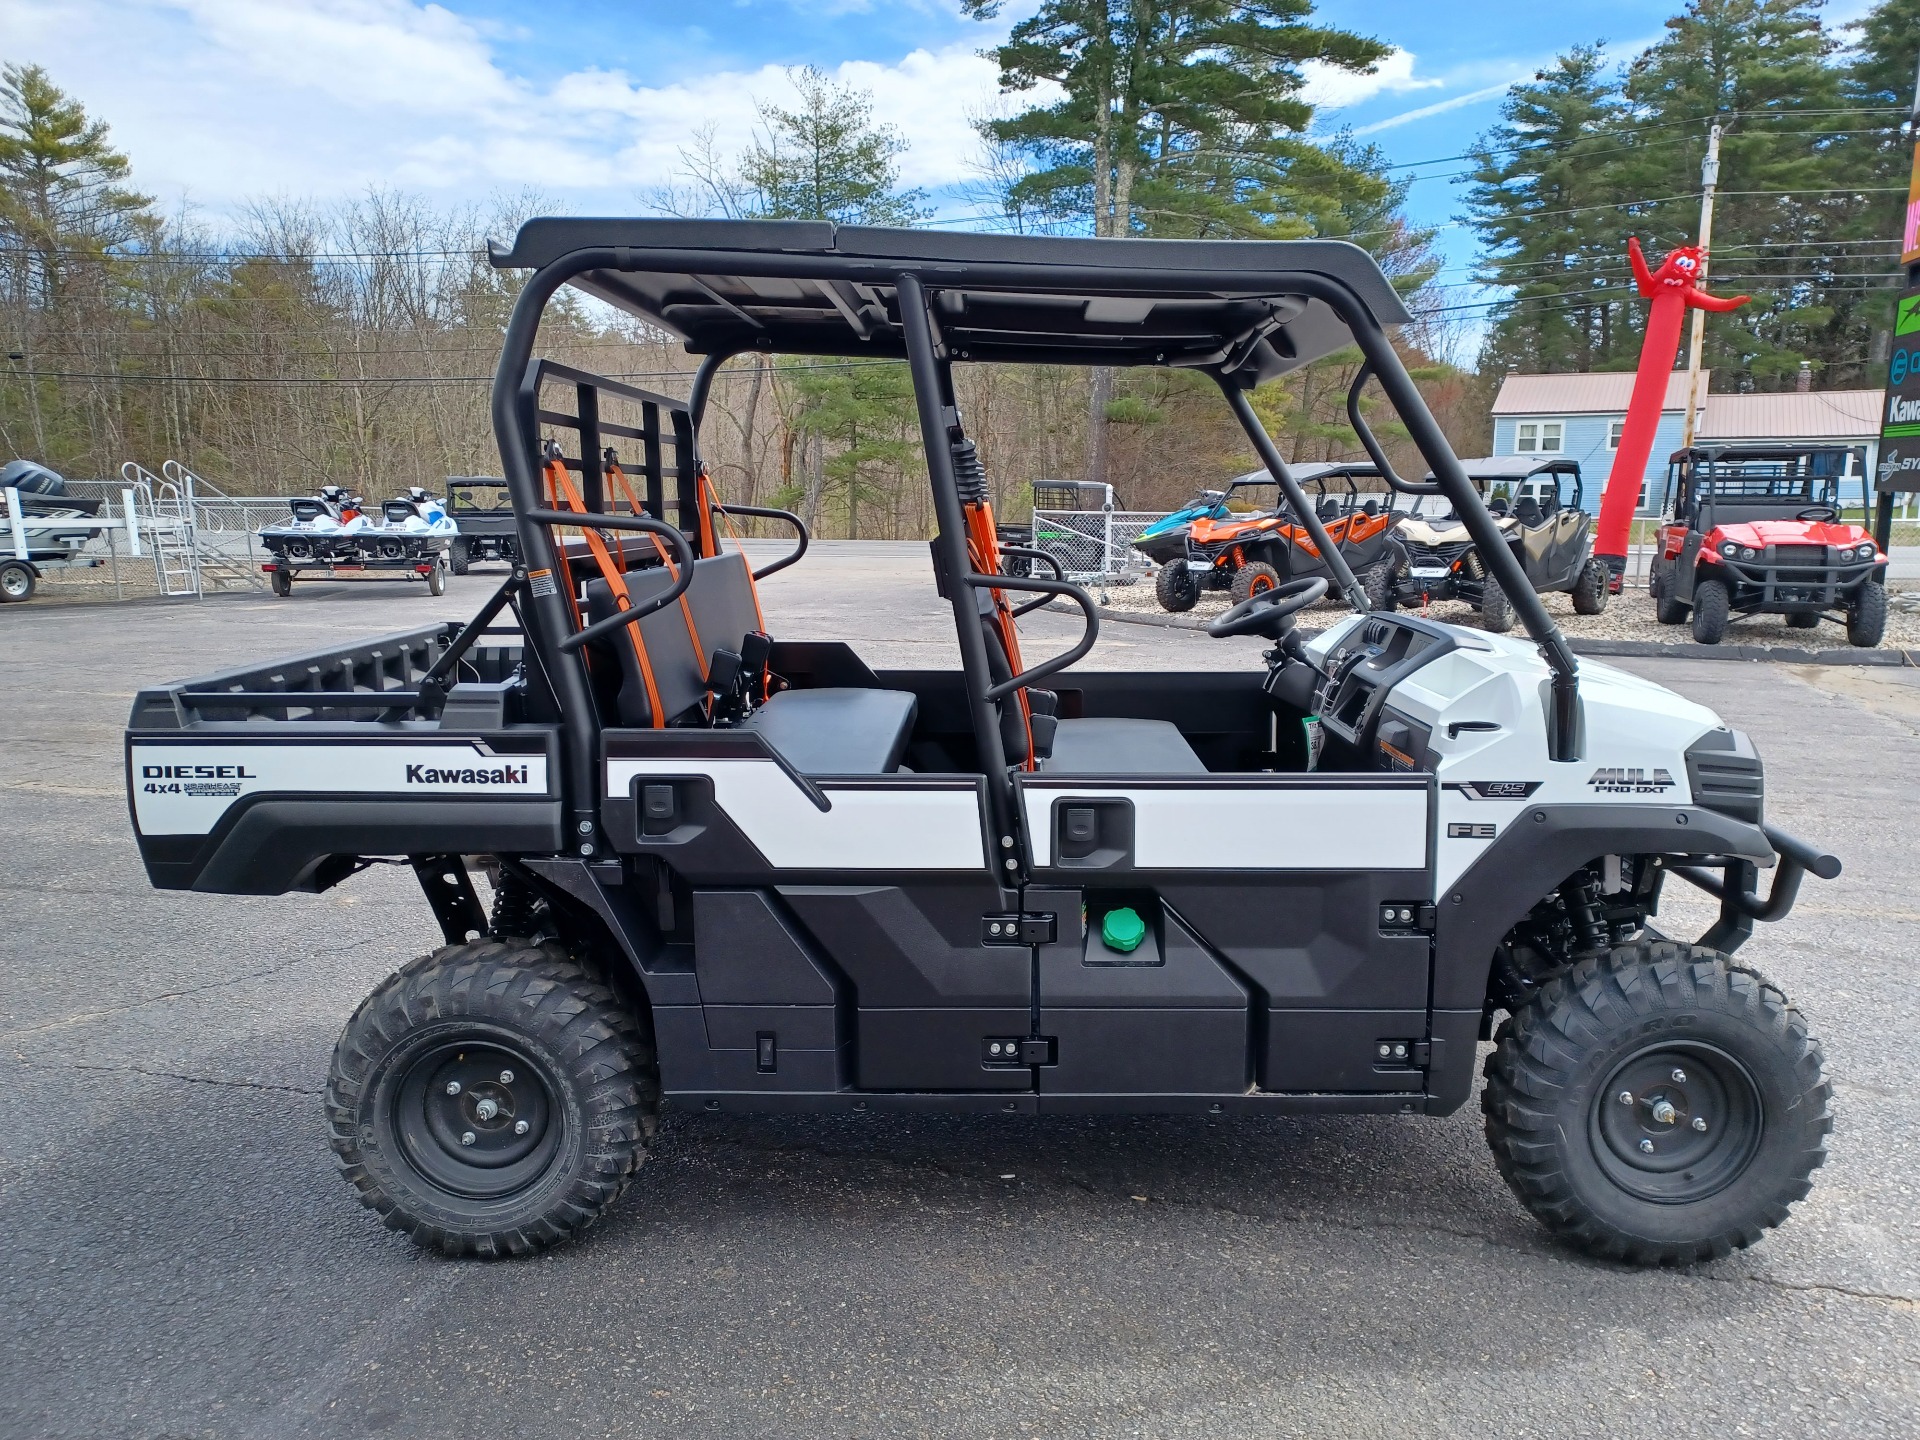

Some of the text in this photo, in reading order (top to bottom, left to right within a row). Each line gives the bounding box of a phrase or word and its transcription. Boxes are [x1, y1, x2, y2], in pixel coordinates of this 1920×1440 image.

[142, 765, 257, 779] DIESEL
[406, 764, 528, 784] Kawasaki
[1587, 767, 1676, 786] MULE
[143, 783, 182, 794] 4x4
[1594, 786, 1668, 794] PRO-DXT
[1449, 824, 1495, 837] FE
